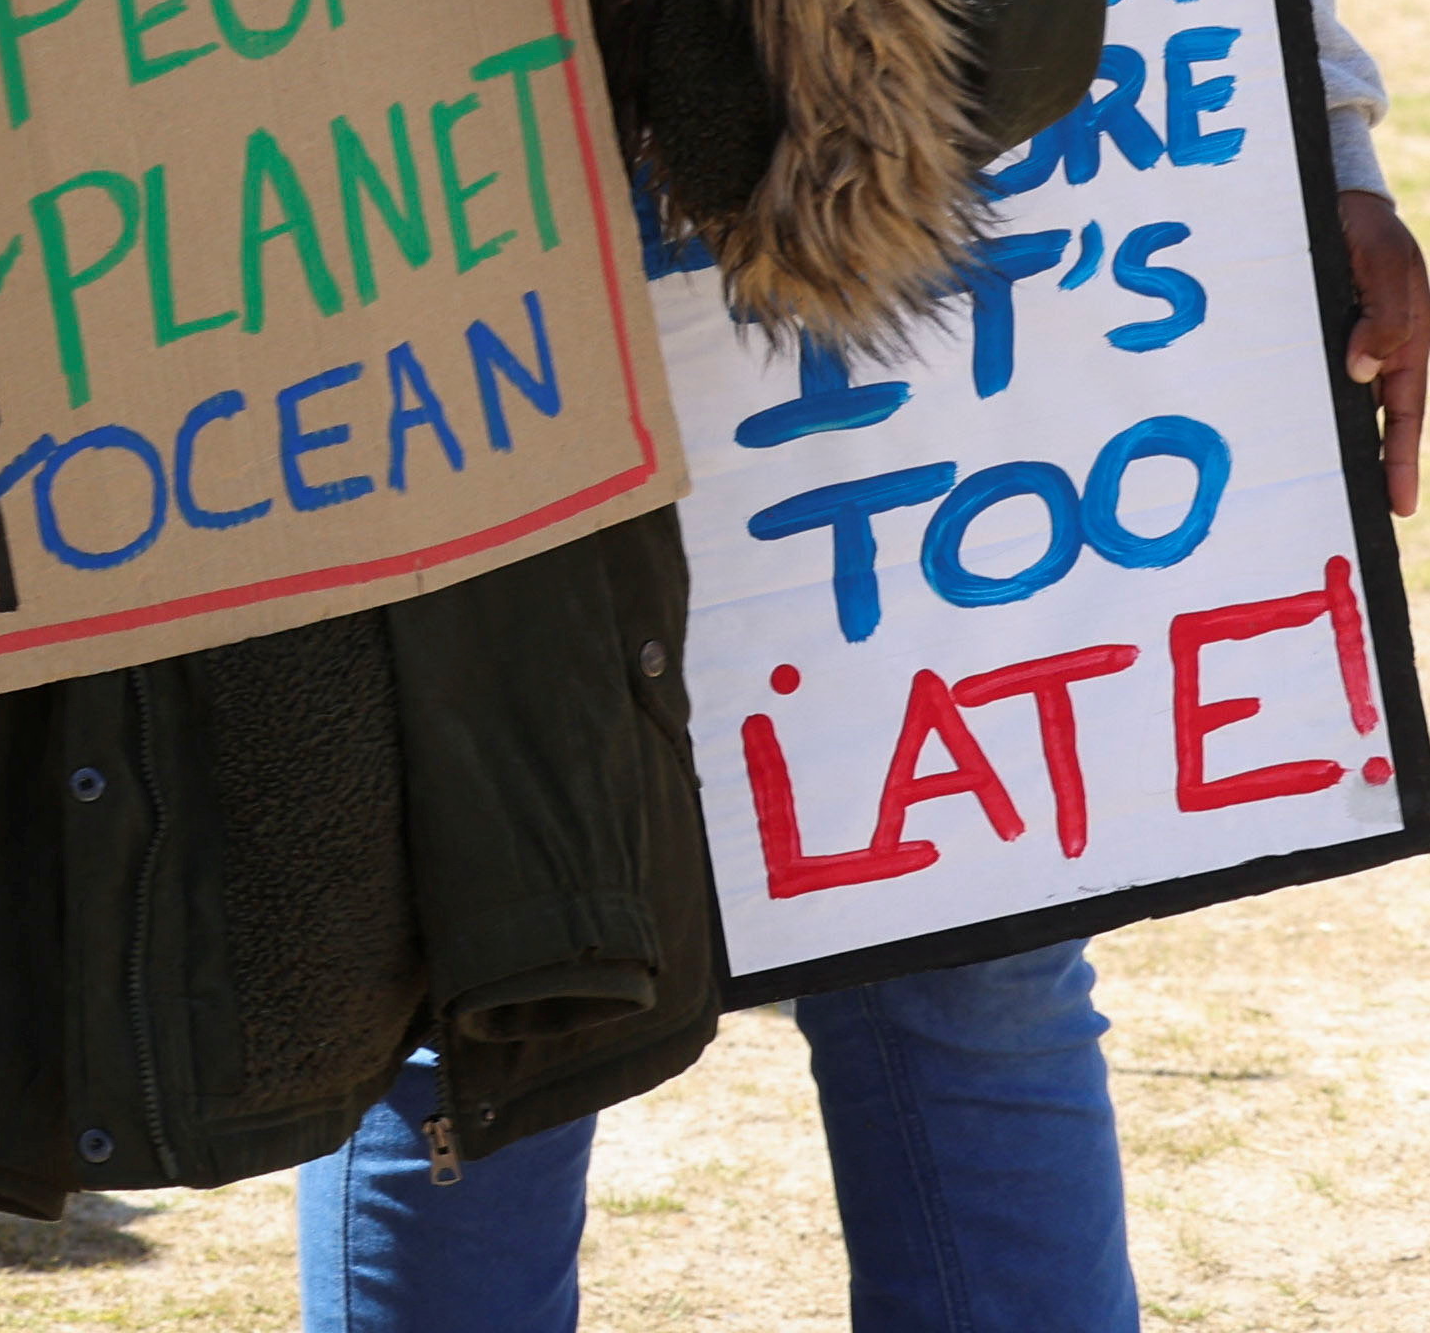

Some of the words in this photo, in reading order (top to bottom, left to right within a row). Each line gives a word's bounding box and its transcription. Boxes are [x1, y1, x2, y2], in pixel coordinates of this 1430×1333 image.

[29, 33, 574, 409] PLANET
[31, 291, 564, 571] OCEAN
[747, 413, 1233, 644] TOO
